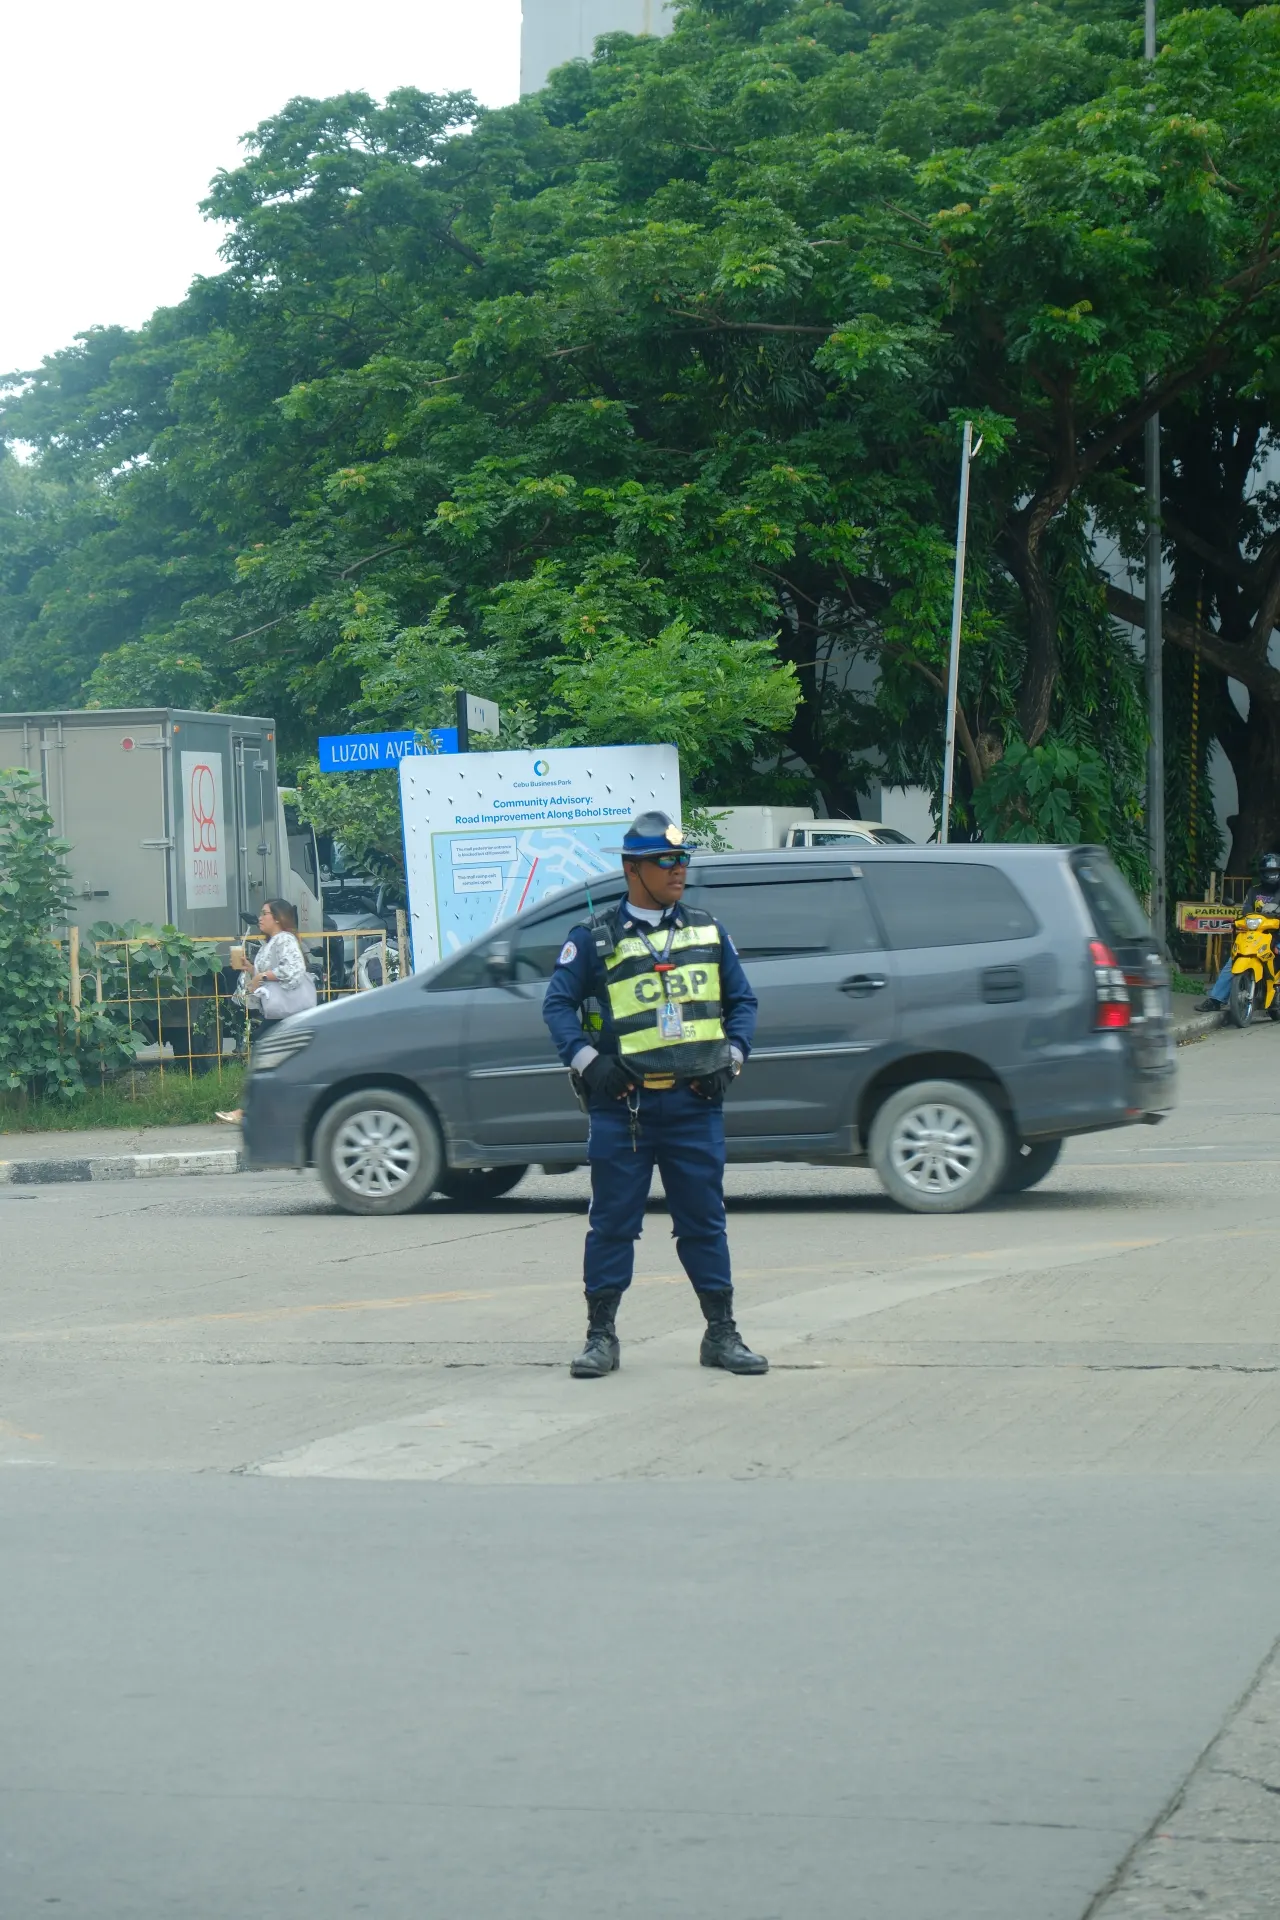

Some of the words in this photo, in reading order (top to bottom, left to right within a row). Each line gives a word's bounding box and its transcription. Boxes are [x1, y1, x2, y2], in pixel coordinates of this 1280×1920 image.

[331, 742, 379, 763] LUZON
[513, 781, 530, 789] Cebu
[530, 780, 557, 788] Business
[493, 797, 548, 809] Community
[549, 795, 593, 807] Advisory:
[455, 813, 479, 824] Road
[481, 810, 545, 825] Improvement
[547, 808, 574, 820] Along
[575, 807, 601, 818] Bohol
[602, 806, 632, 816] Street
[193, 859, 219, 879] PRIMA
[1195, 908, 1244, 916] PARKING
[634, 969, 708, 1004] CBP
[683, 1025, 696, 1038] 56
